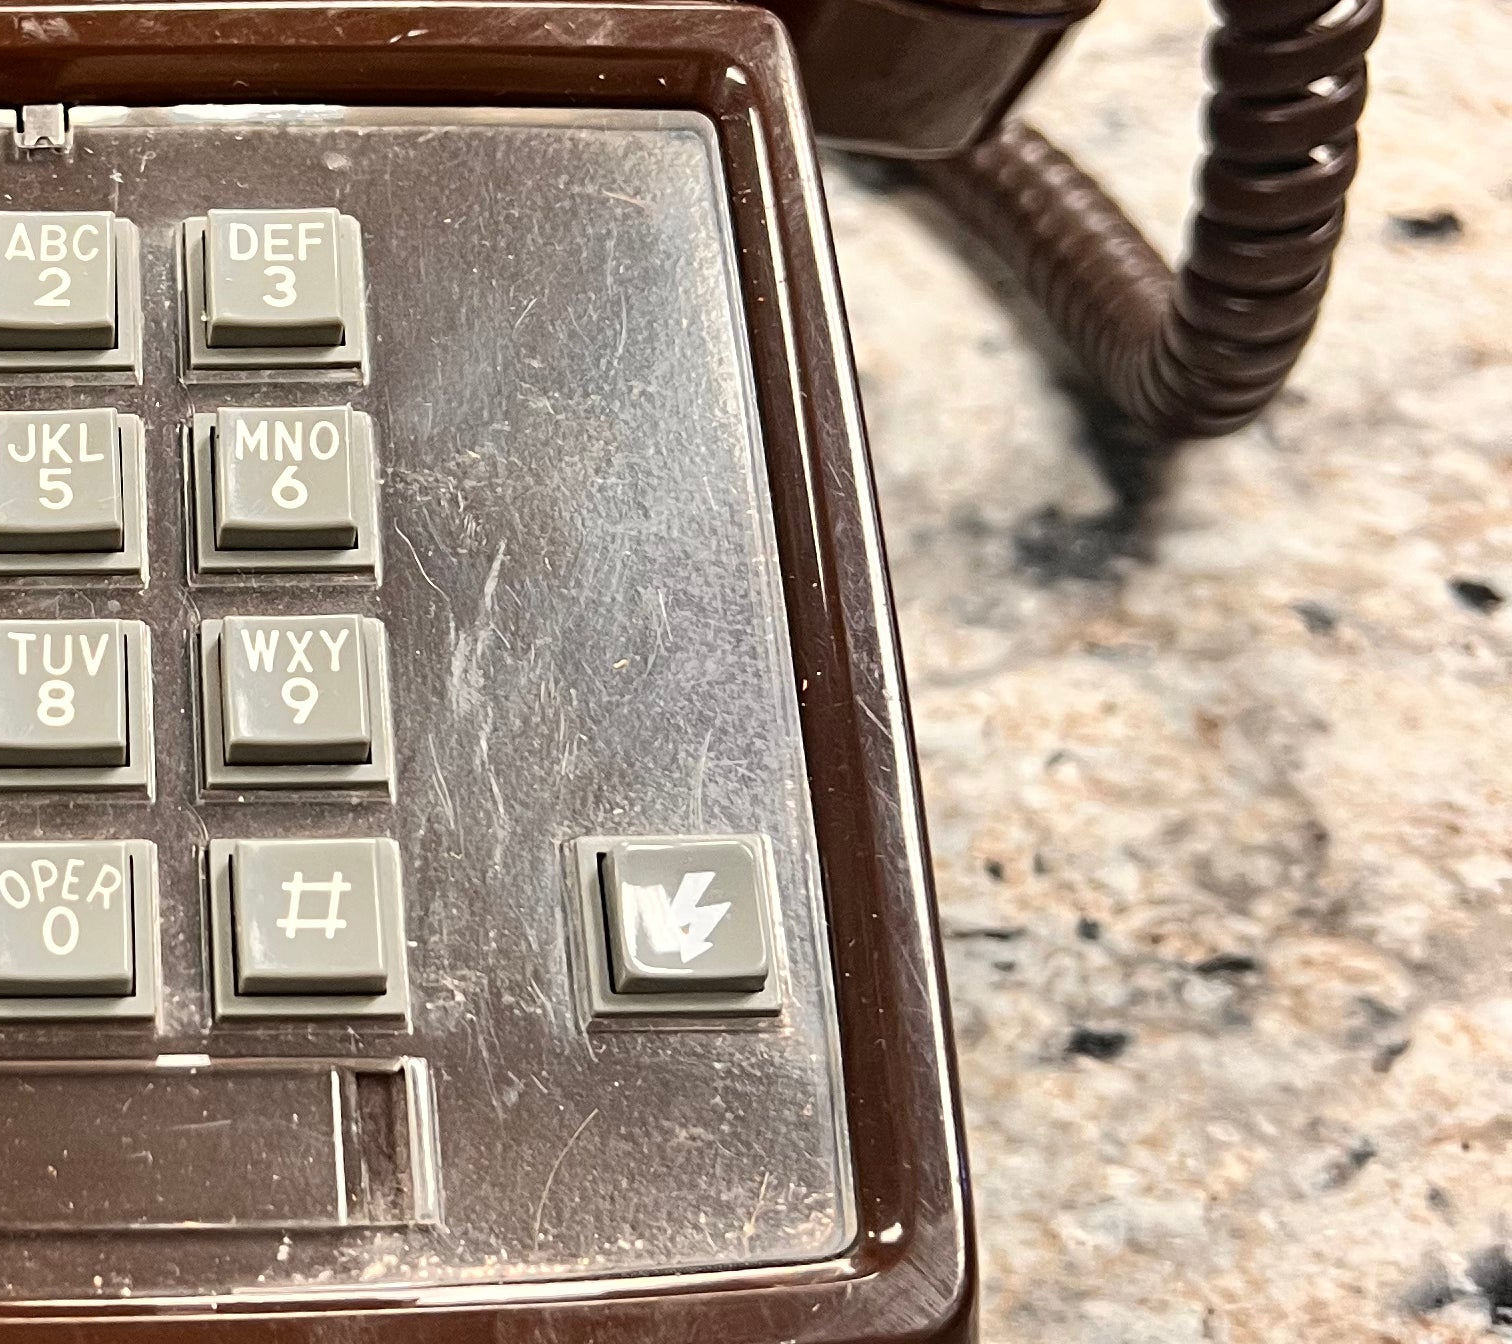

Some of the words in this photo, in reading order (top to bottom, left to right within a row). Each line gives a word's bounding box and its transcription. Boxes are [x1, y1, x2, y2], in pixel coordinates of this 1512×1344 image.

[4, 224, 100, 261] ABC
[229, 222, 326, 261] DEF
[34, 267, 71, 308] 2
[262, 266, 298, 308] 3
[7, 423, 104, 464] JKL
[234, 420, 340, 461] MNO
[38, 467, 74, 511] 5
[271, 466, 308, 510] 6
[7, 632, 110, 676] TUV
[240, 628, 349, 674] WXY
[37, 680, 76, 727] 8
[281, 676, 319, 724] 9
[42, 907, 80, 956] 0
